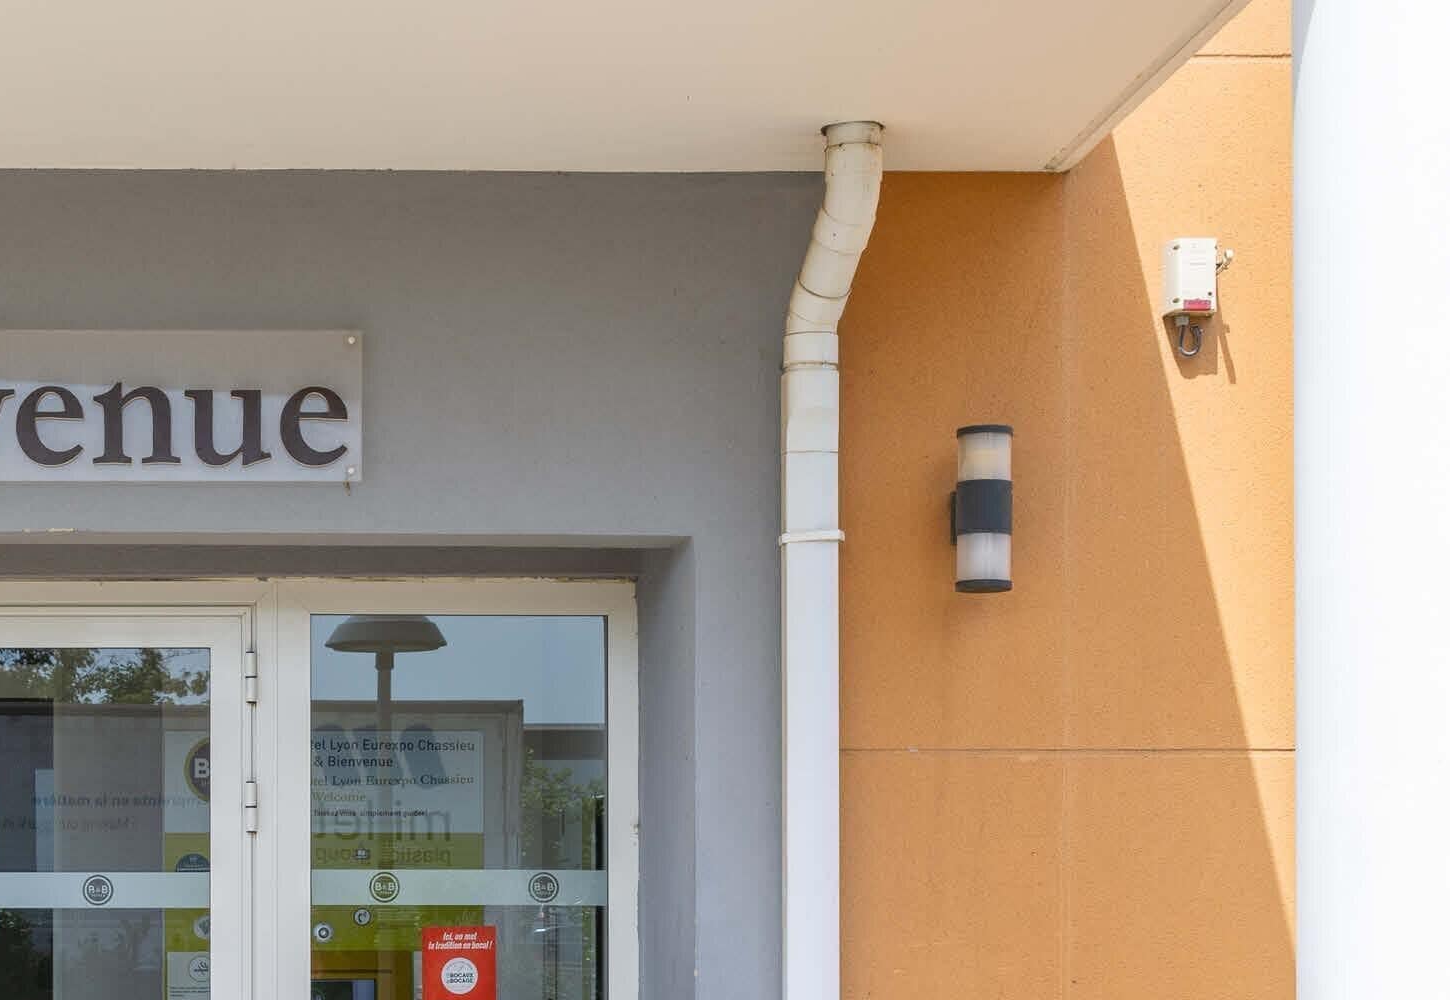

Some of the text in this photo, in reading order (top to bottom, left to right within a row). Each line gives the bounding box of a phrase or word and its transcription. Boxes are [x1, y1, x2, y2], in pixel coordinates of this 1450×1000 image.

[330, 739, 358, 752] Lyon
[363, 739, 414, 752] Eurexpo
[418, 739, 475, 751] Chassieu
